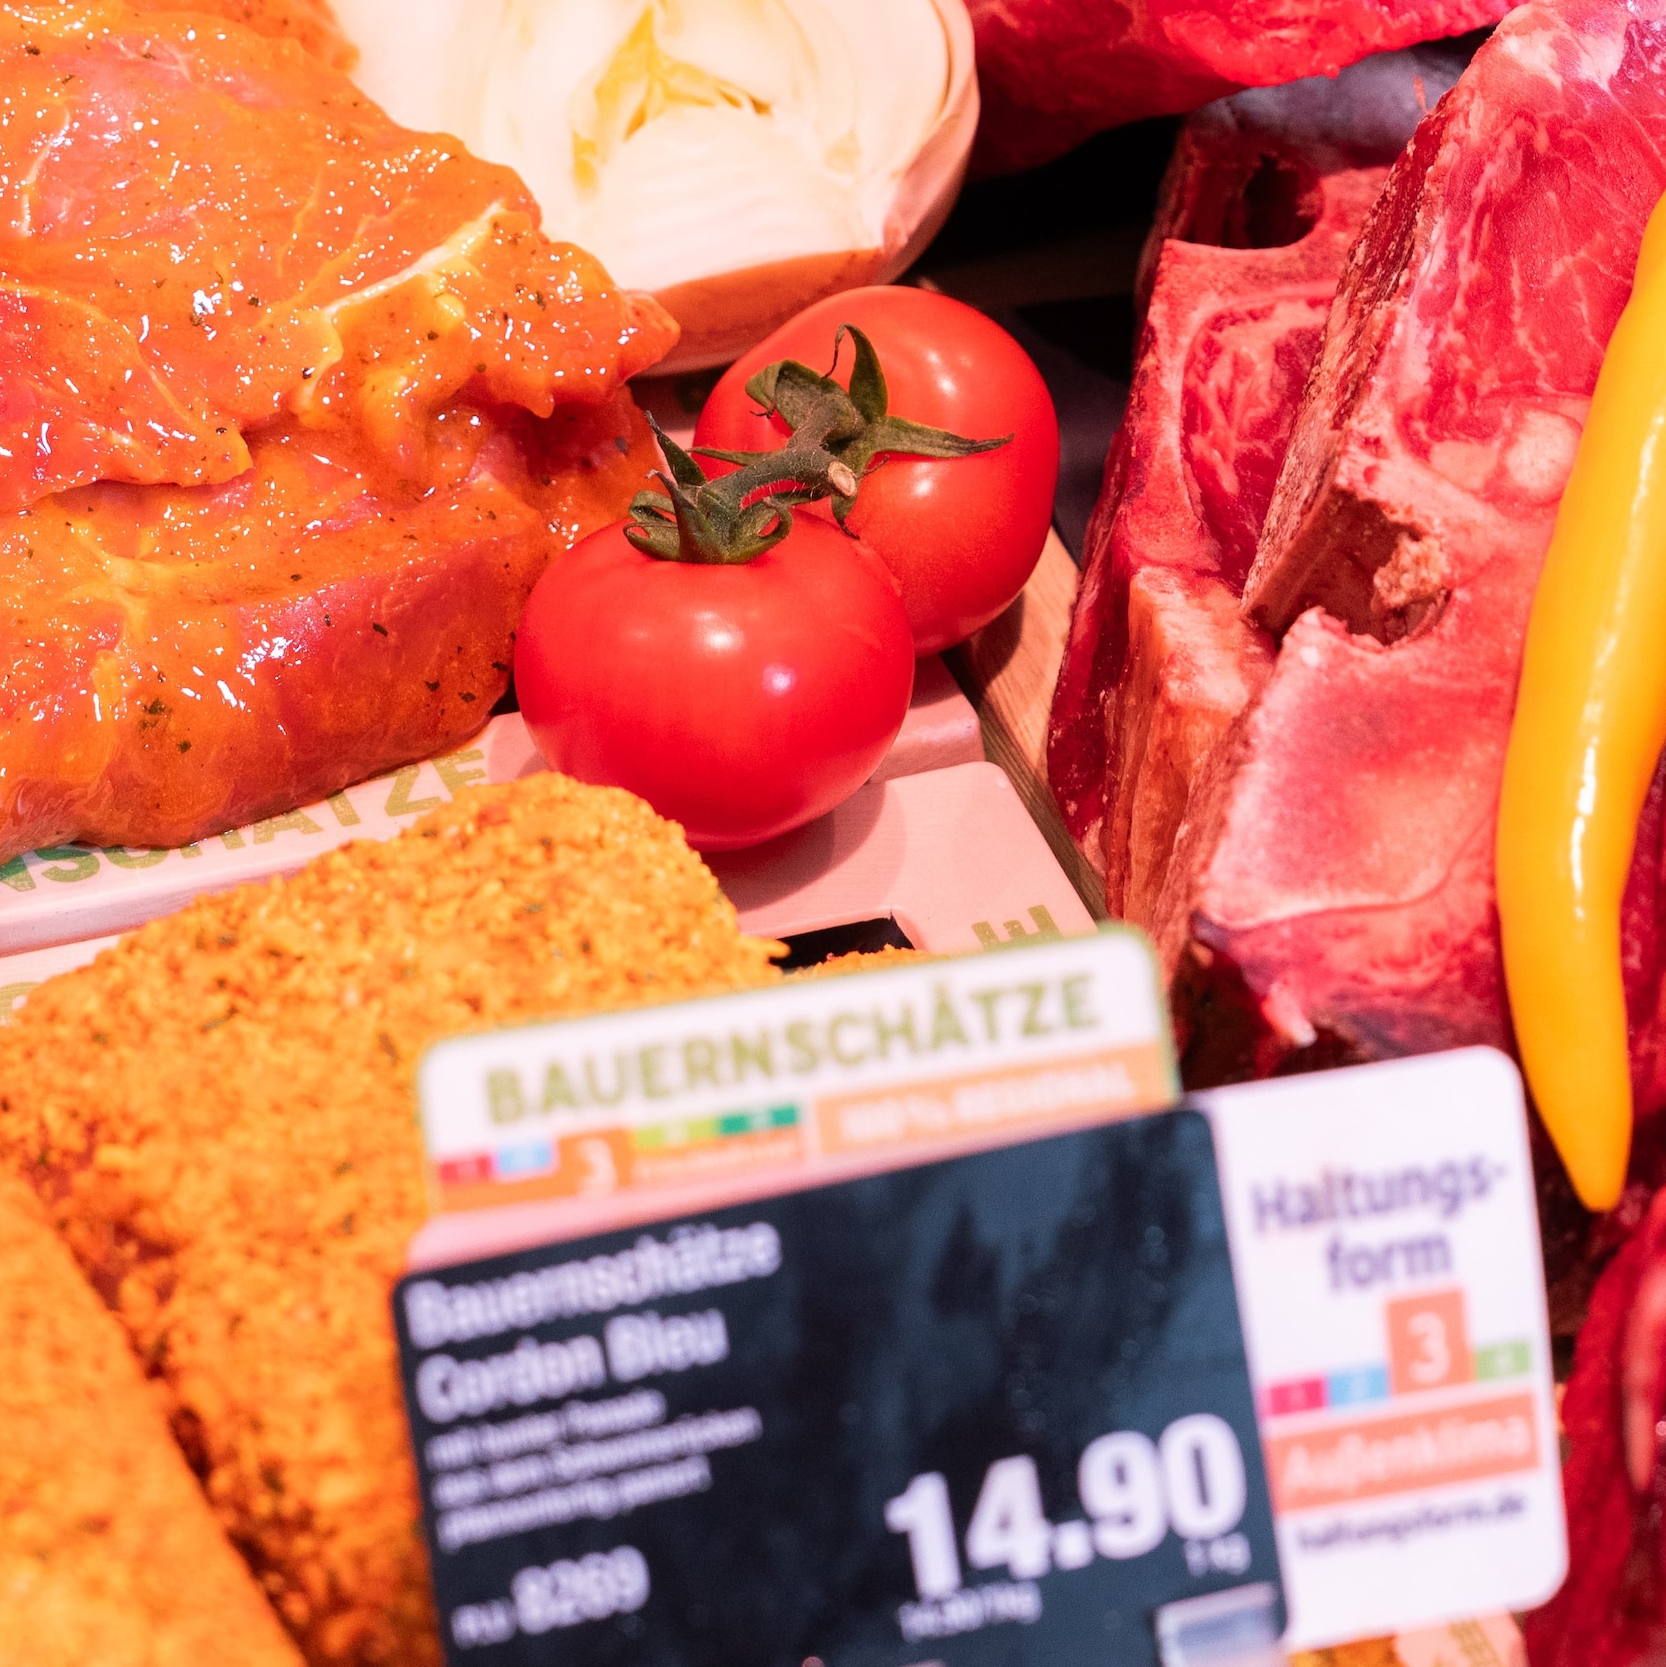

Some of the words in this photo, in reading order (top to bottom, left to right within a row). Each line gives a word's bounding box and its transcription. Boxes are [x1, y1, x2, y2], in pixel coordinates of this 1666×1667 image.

[484, 972, 1101, 1125] BAUERNSCHÄTZE
[1251, 1154, 1507, 1238] Haltungs-
[404, 1222, 781, 1349] Bauernschätze
[1327, 1233, 1452, 1295] form
[416, 1335, 605, 1423] Cordon
[604, 1308, 729, 1382] Bleu
[1407, 1312, 1451, 1383] 3
[884, 1412, 1247, 1601] 14.90
[513, 1544, 651, 1635] 8269
